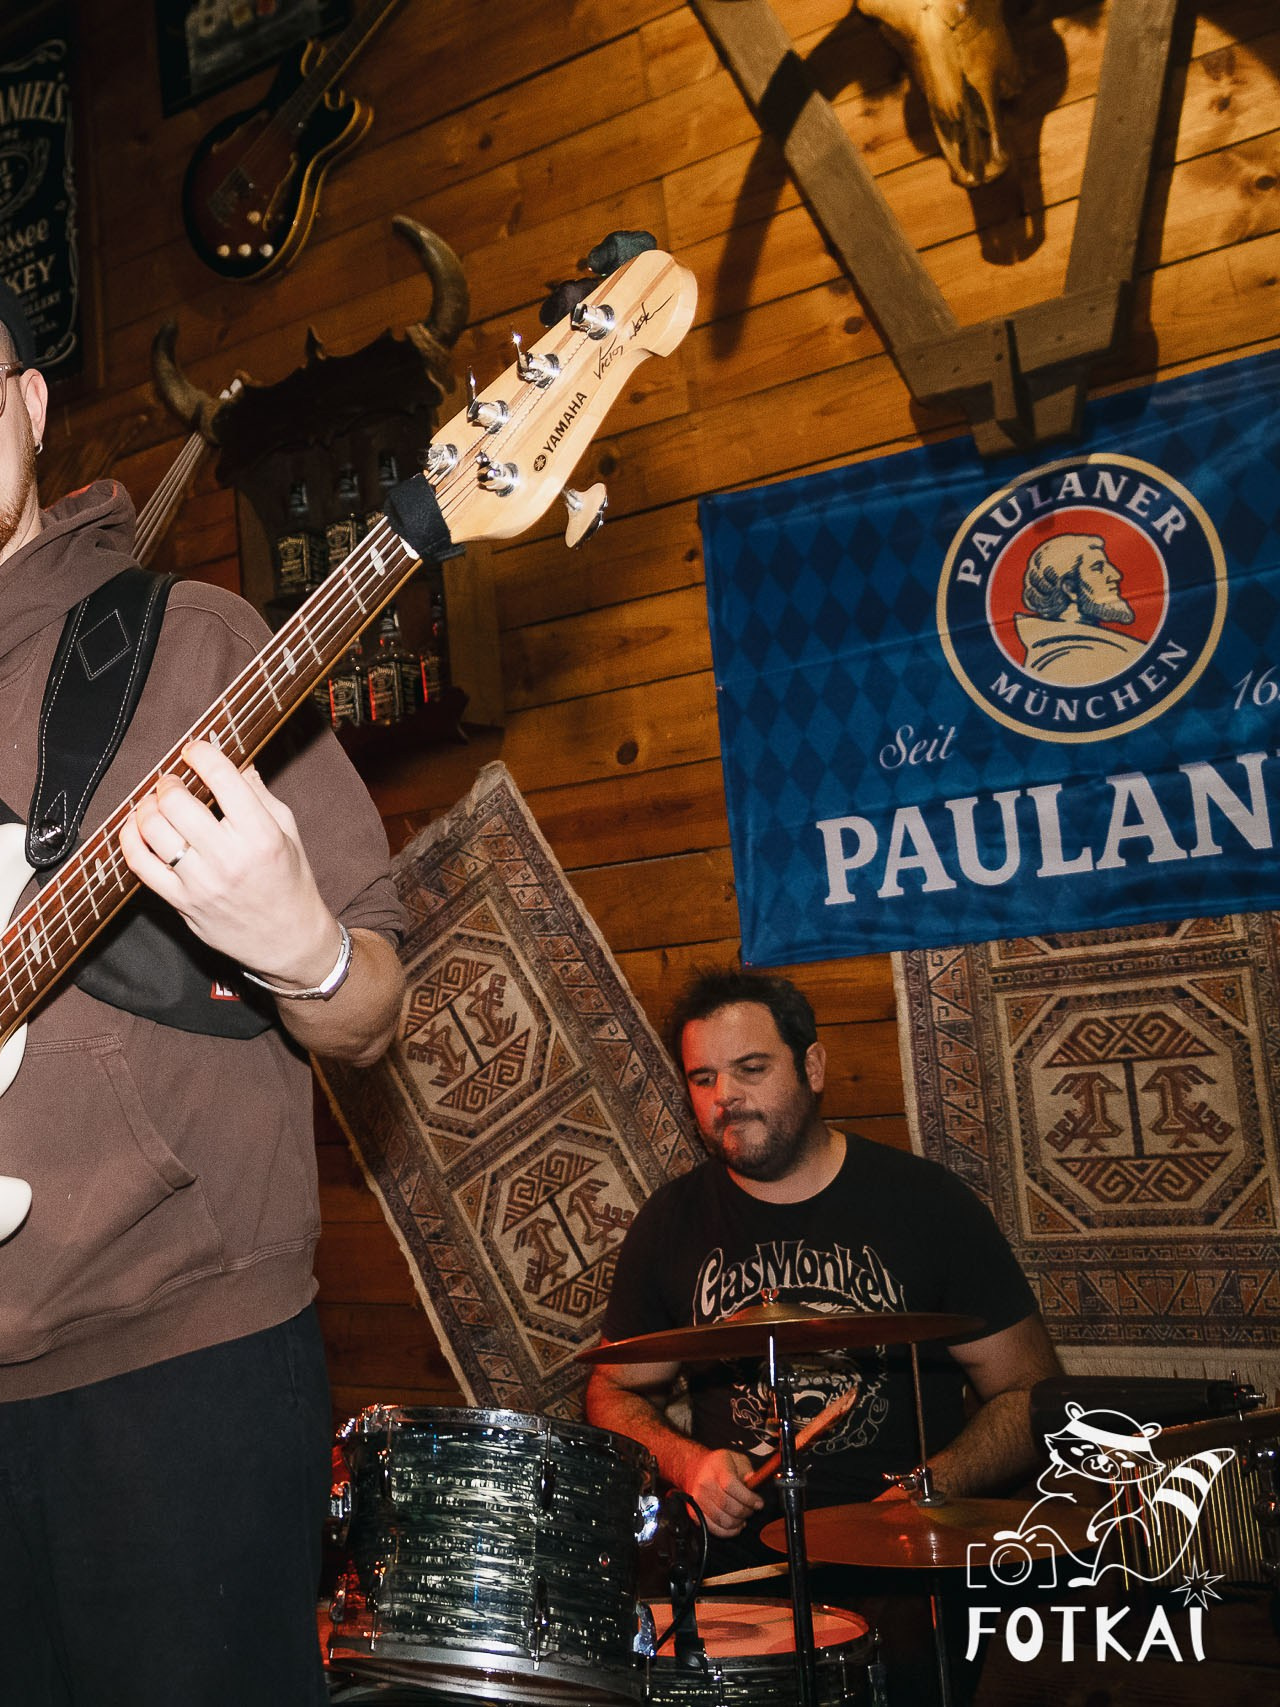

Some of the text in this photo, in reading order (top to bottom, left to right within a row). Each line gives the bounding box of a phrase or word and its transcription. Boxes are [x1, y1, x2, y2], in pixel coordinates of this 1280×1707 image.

[543, 392, 587, 453] YAMAHA
[956, 469, 1188, 587] PAULANER
[878, 665, 1280, 770] Seit 16
[989, 638, 1190, 723] MÜNCHEN
[816, 748, 1280, 906] PAULAN
